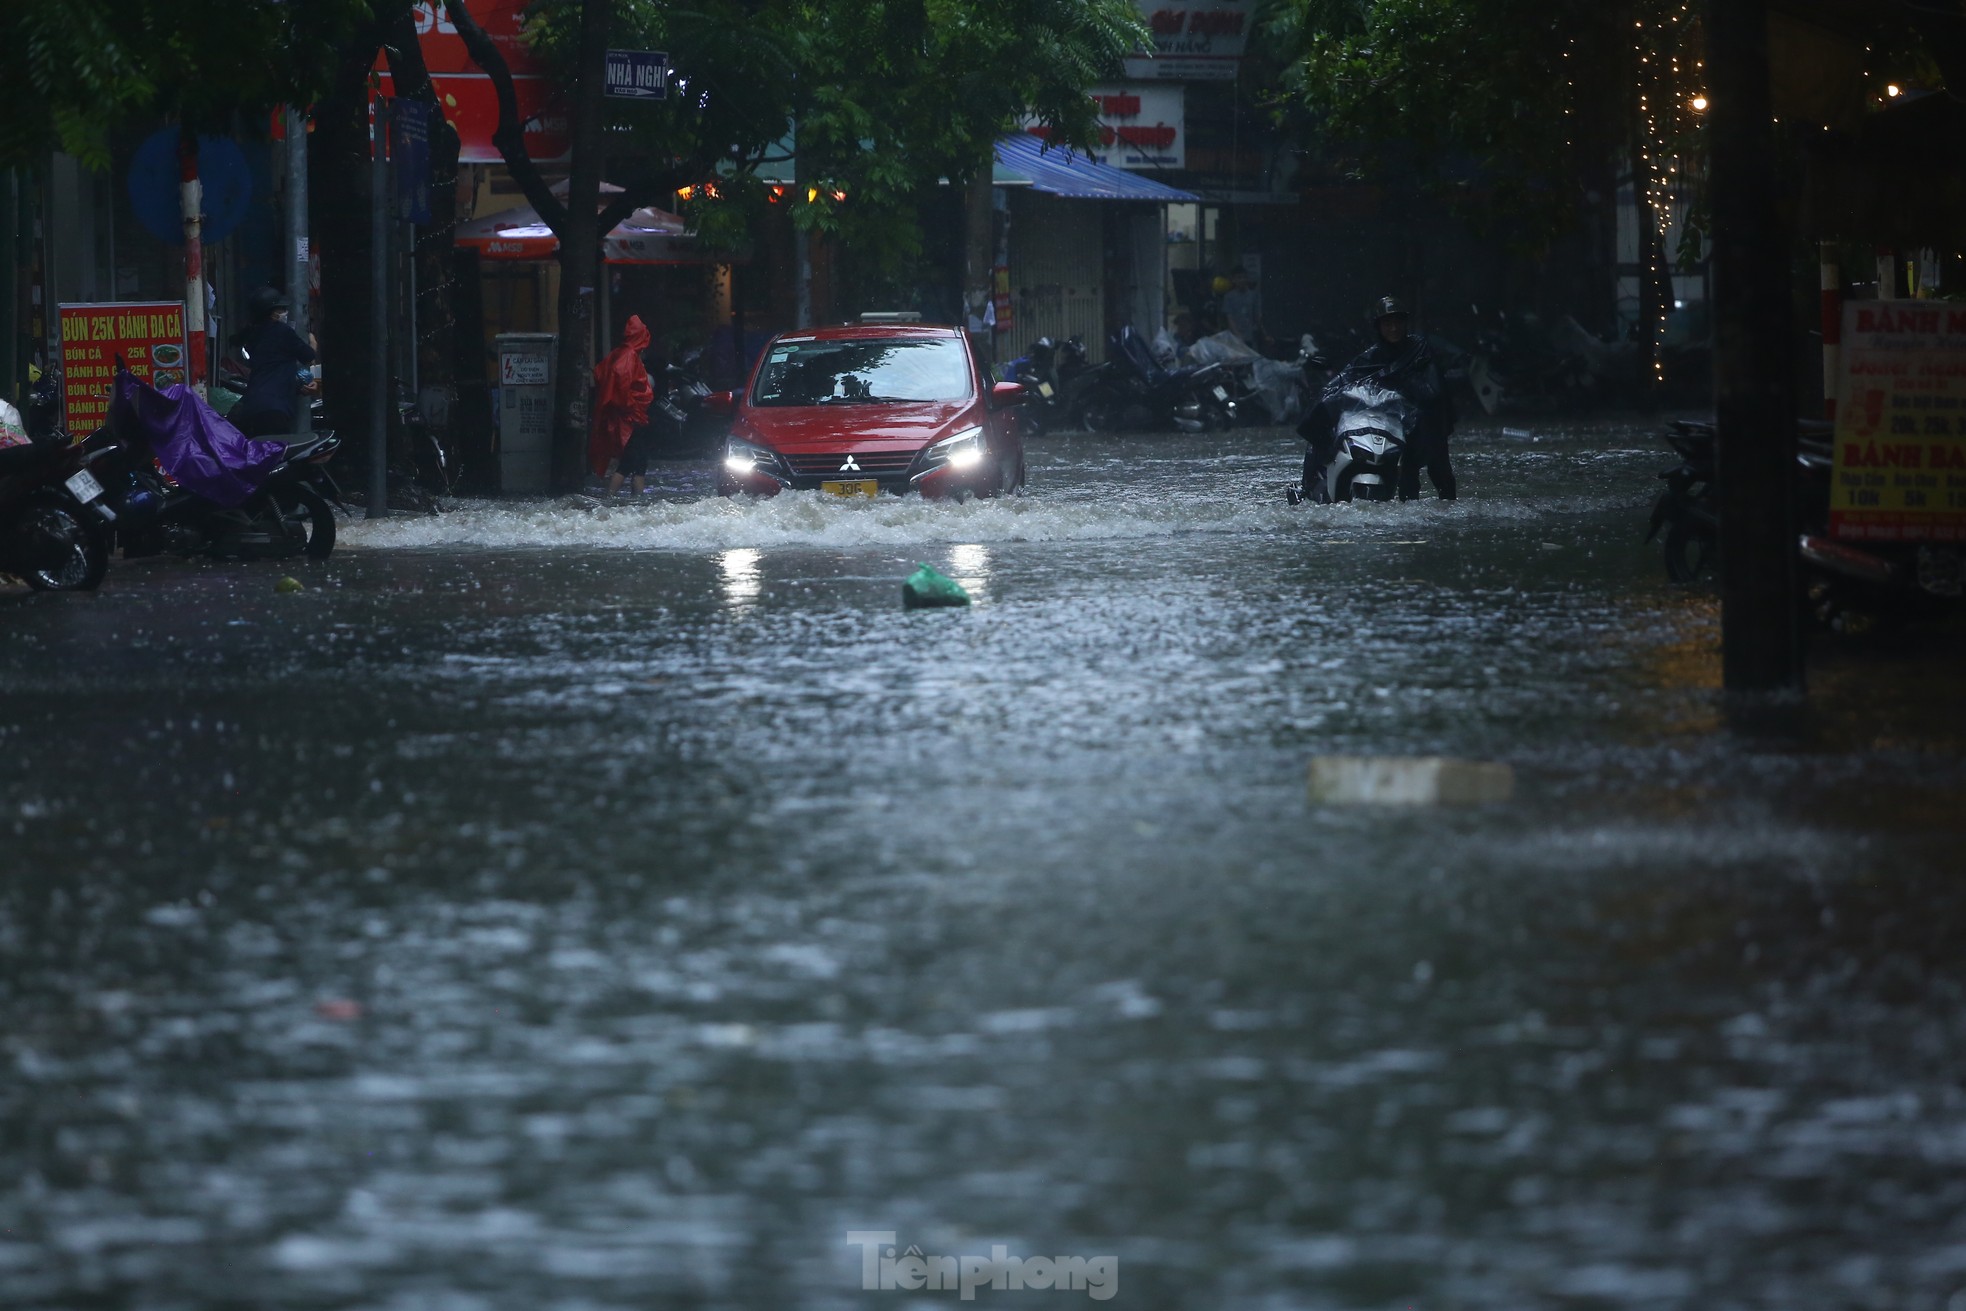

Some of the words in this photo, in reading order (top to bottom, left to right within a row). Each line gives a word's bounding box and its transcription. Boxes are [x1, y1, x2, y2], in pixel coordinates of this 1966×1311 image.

[607, 59, 632, 85] NHÀ
[636, 58, 667, 87] NGHỈ
[503, 241, 524, 252] MSB
[62, 312, 88, 341] BÚN
[92, 316, 115, 340] 25K
[119, 310, 148, 339] BÁNH
[151, 315, 165, 338] ĐA
[167, 309, 181, 337] CÁ
[1856, 304, 1940, 334] BÁNH
[1946, 309, 1966, 335] M
[65, 347, 85, 360] BÚN
[88, 346, 102, 360] CÁ
[128, 347, 146, 359] 25K
[66, 364, 93, 379] BÁNH
[96, 366, 109, 377] ĐA
[112, 366, 119, 376] C
[131, 365, 149, 376] 25K
[67, 383, 86, 396] BÚN
[89, 383, 102, 396] CÁ
[68, 400, 95, 414] BÁNH
[69, 417, 94, 431] BÁNH
[97, 418, 106, 428] Đ
[1843, 440, 1922, 467] BÁNH
[1930, 444, 1966, 468] BA
[838, 483, 863, 495] 30G
